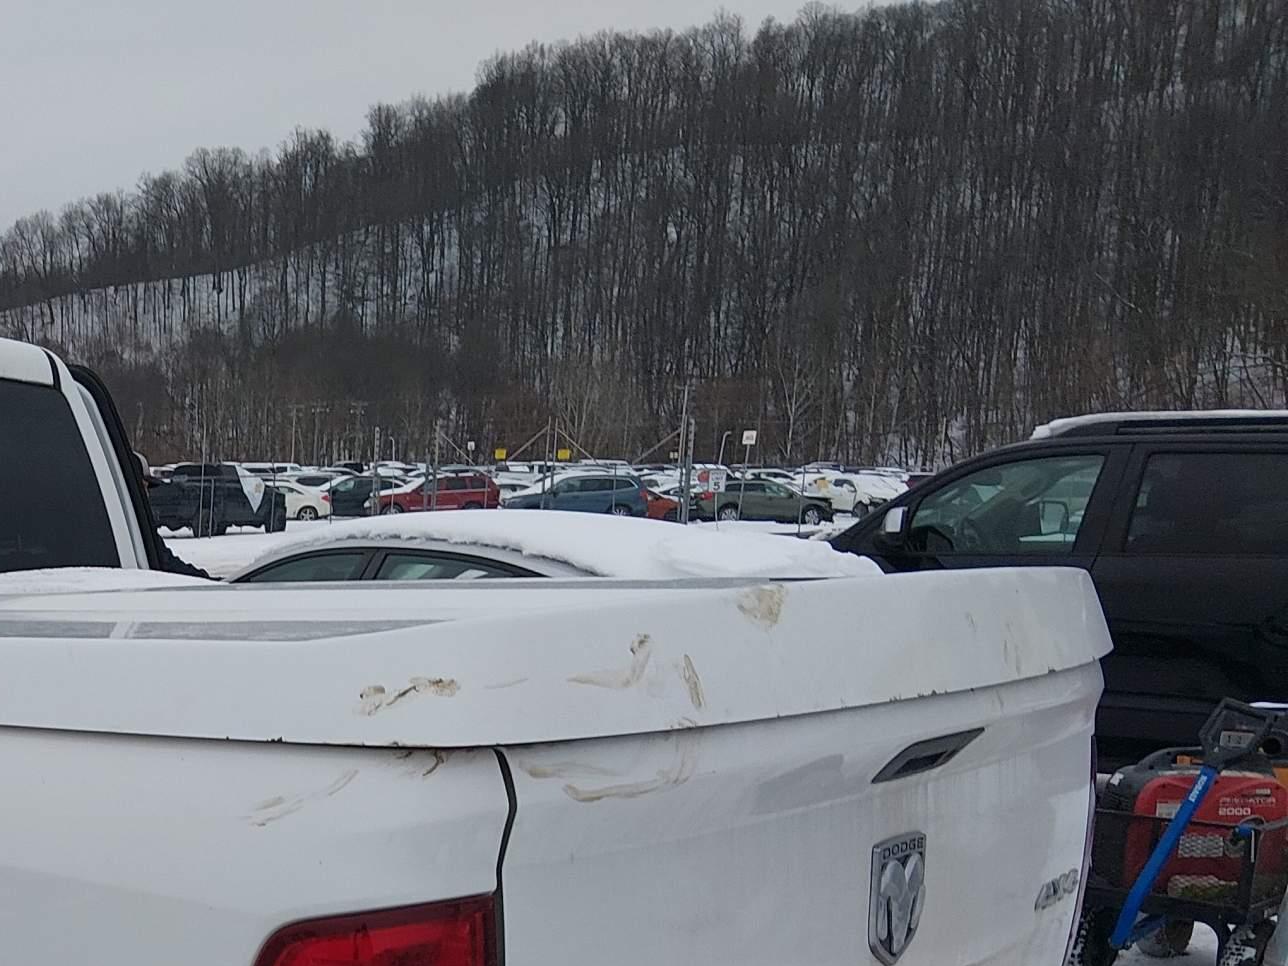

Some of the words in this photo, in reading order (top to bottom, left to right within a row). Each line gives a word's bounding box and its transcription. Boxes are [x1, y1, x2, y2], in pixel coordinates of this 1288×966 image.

[713, 482, 721, 491] 5
[1218, 807, 1252, 816] 2000
[882, 837, 924, 860] DODGE
